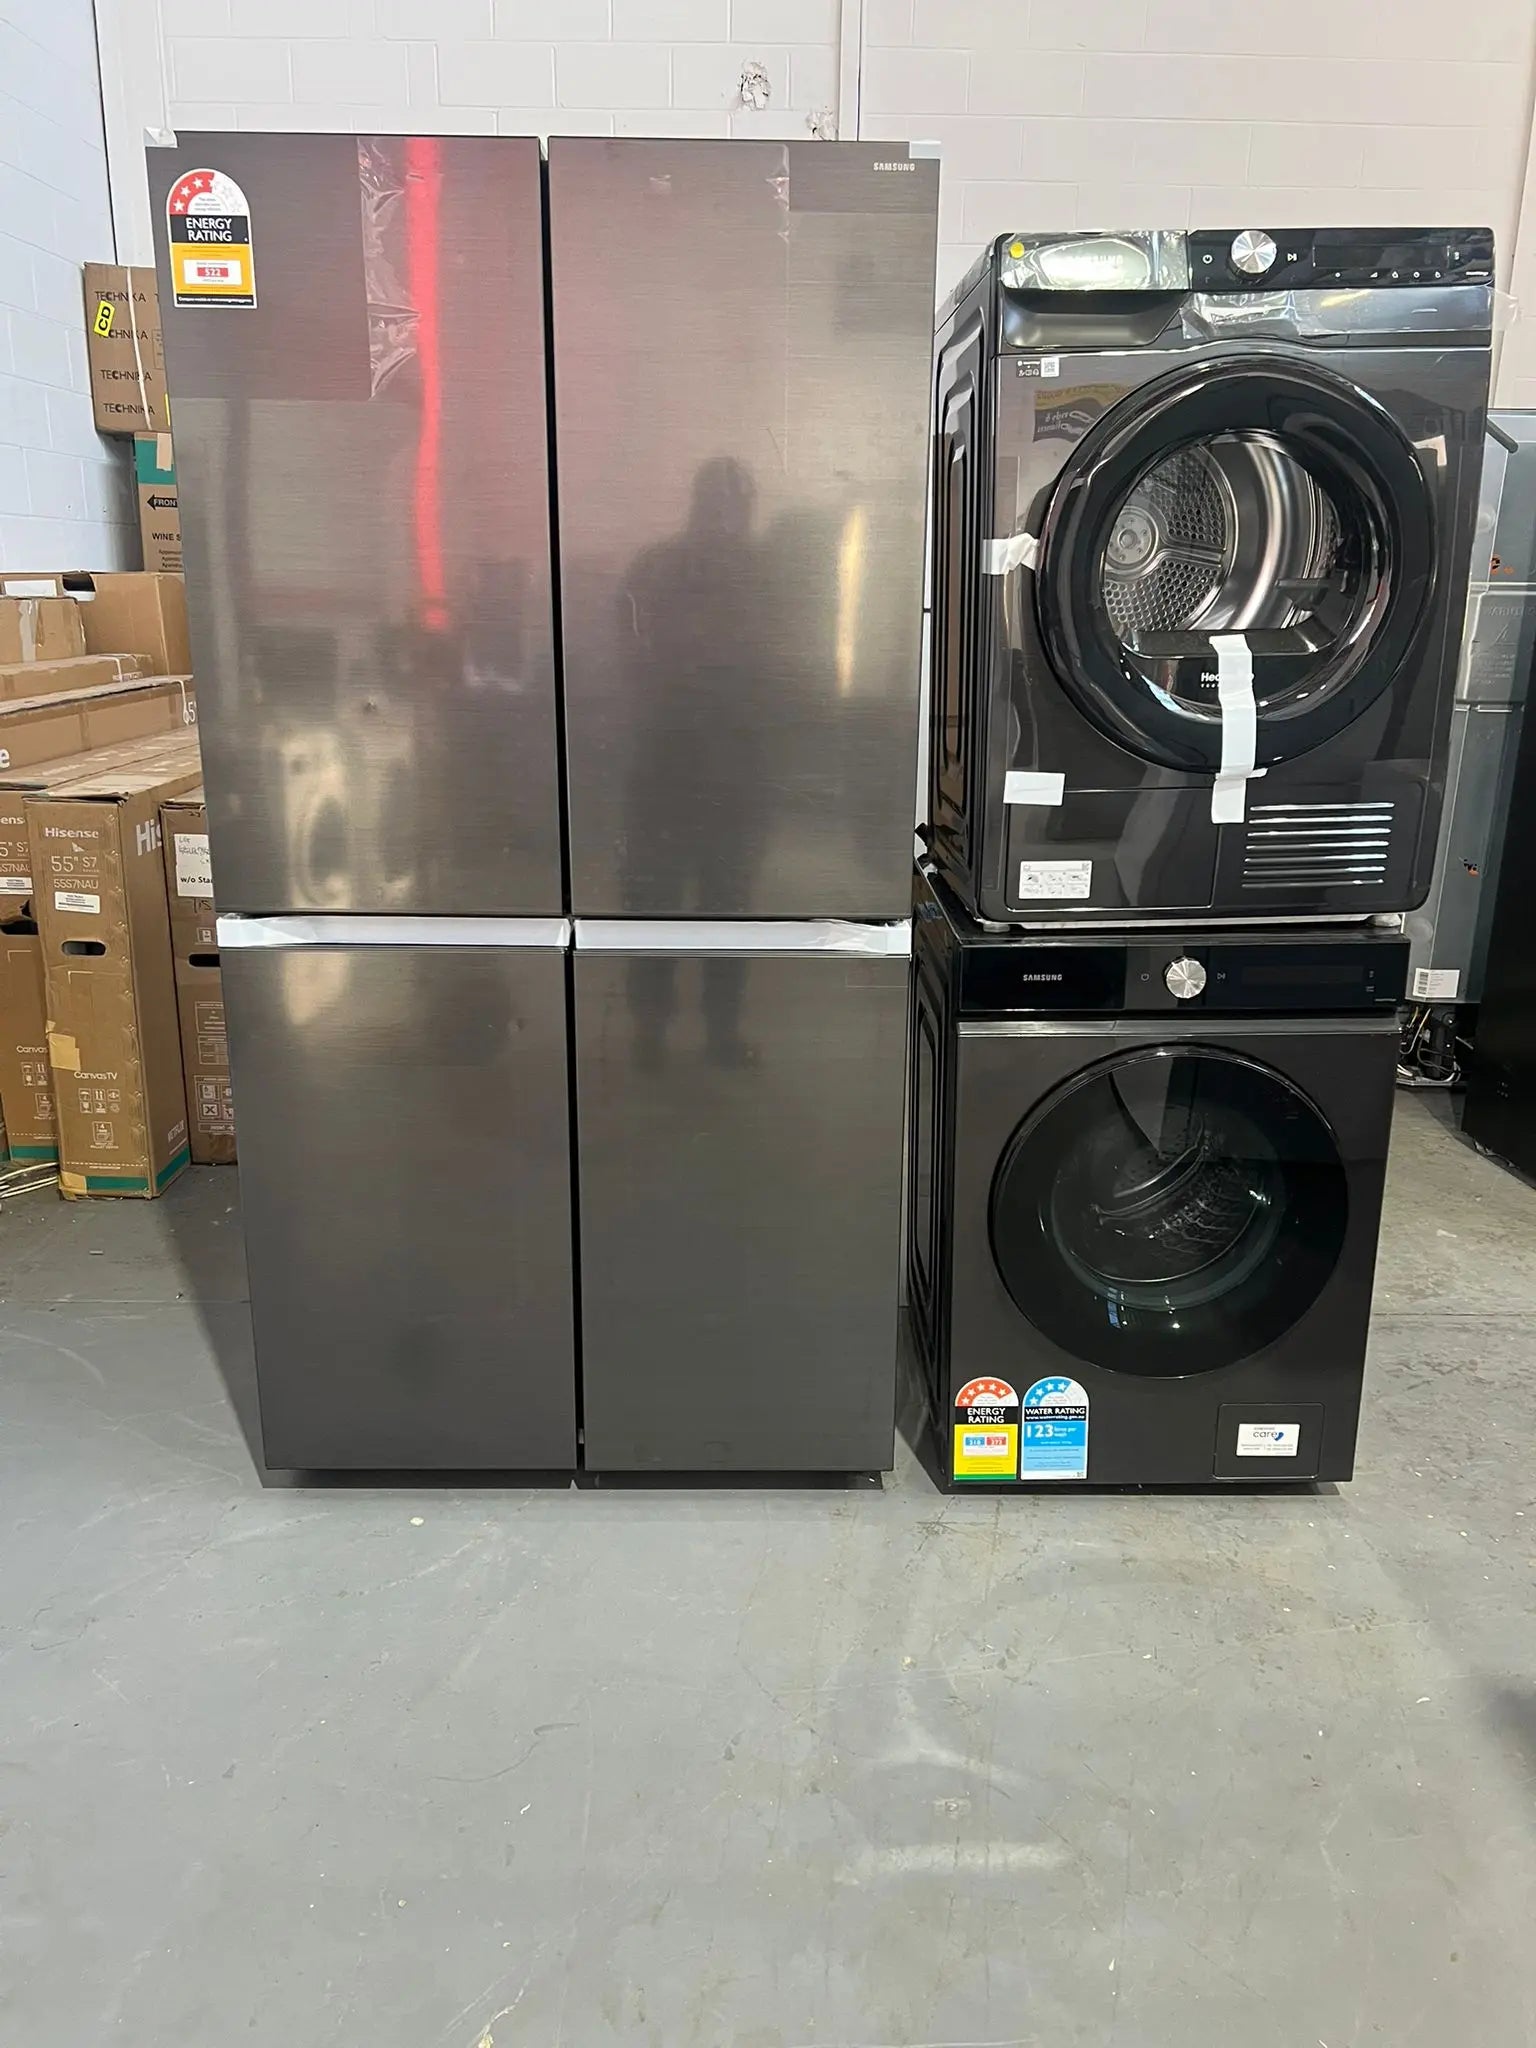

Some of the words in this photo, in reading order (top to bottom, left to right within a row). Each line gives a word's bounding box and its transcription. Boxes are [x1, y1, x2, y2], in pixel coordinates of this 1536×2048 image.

[873, 162, 916, 171] SAMSUNG
[185, 217, 232, 229] ENERGY
[187, 230, 233, 241] RATING
[94, 290, 146, 303] TECHNKA
[98, 306, 111, 331] CD
[153, 498, 177, 507] FRON
[152, 532, 174, 541] WINE
[0, 816, 25, 825] ens
[44, 827, 99, 839] Hisense
[0, 841, 13, 857] 5"
[82, 856, 97, 868] S7
[180, 876, 196, 884] w/o
[198, 876, 213, 884] Sta
[16, 1045, 48, 1054] Canvas
[967, 1407, 1006, 1416] ENERGY
[1025, 1407, 1053, 1415] WATER
[1054, 1407, 1085, 1415] RATING
[968, 1415, 1005, 1424] RATING
